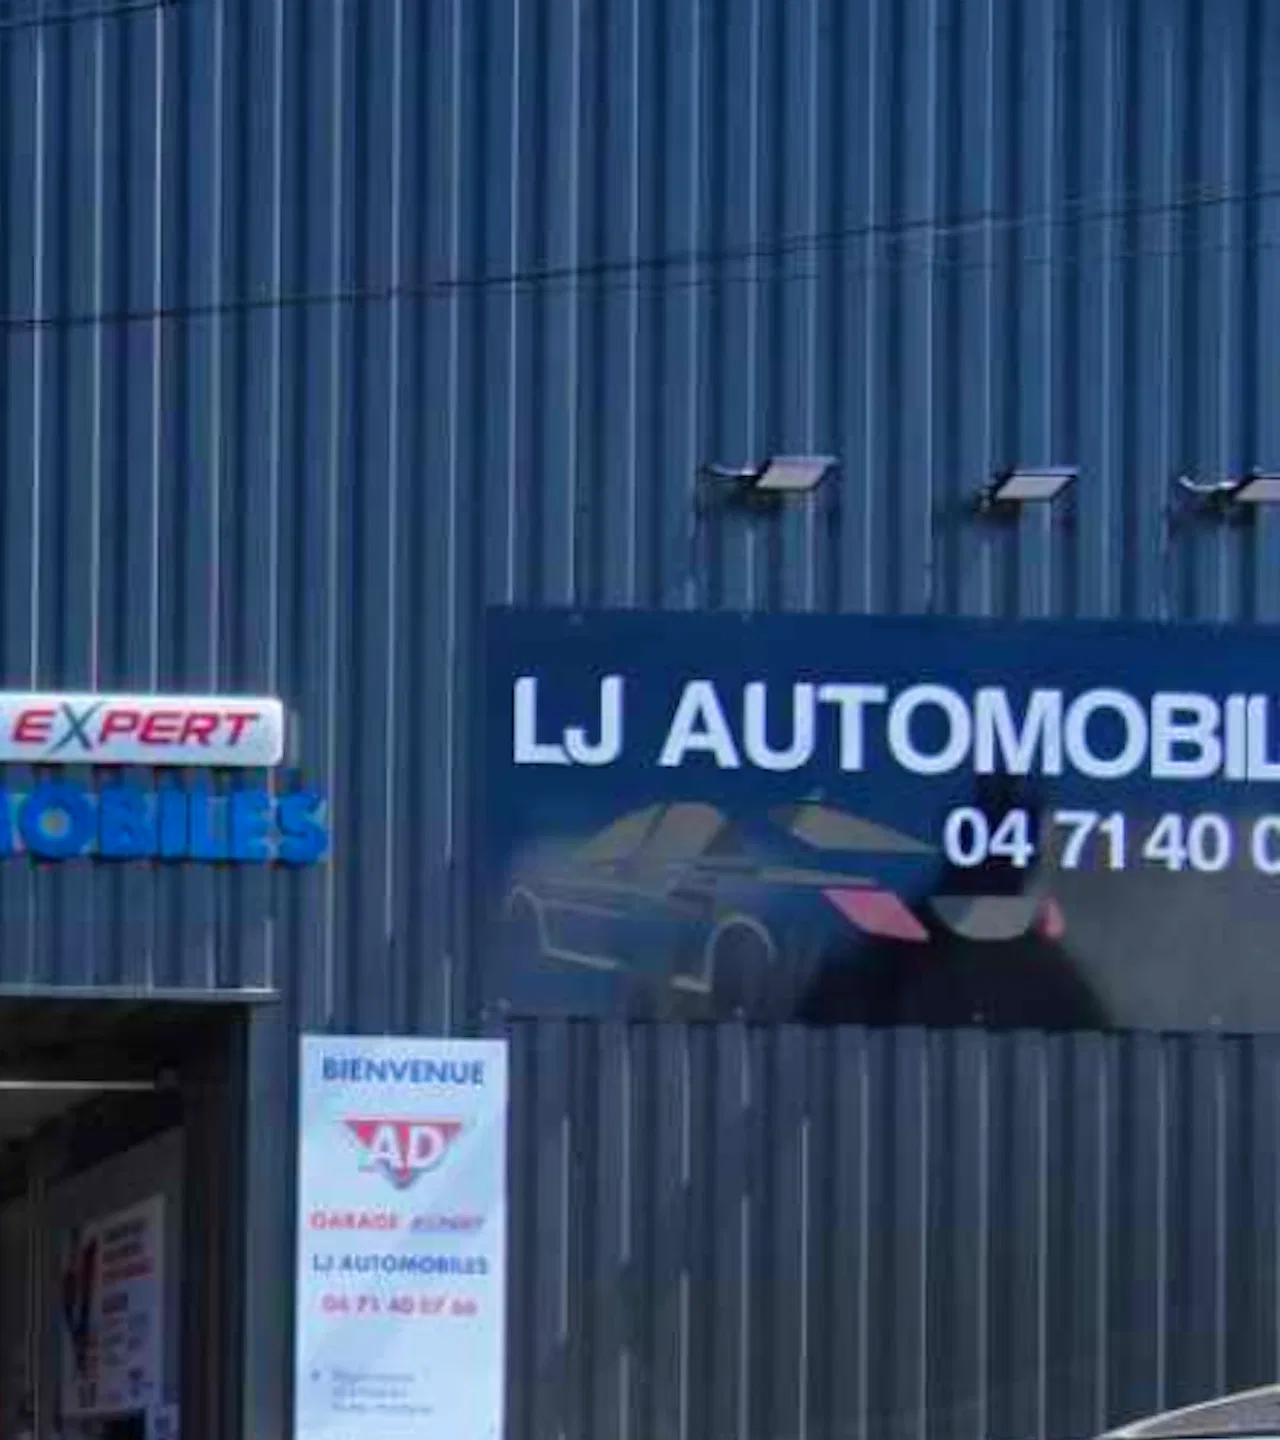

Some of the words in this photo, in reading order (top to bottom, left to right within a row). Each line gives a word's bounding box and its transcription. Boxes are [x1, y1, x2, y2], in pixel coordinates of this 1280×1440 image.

[11, 701, 259, 750] EXPERT
[512, 675, 623, 769] LJ
[657, 680, 1280, 782] AUTOMOBIL
[943, 808, 1034, 869] 04
[1055, 812, 1125, 871] 71
[1143, 813, 1230, 872] 40
[321, 1057, 485, 1084] BIENVENUE
[359, 1123, 445, 1172] AD
[309, 1211, 398, 1231] GARAGE
[313, 1254, 333, 1273] LJ
[341, 1254, 487, 1275] AUTOMOBILES
